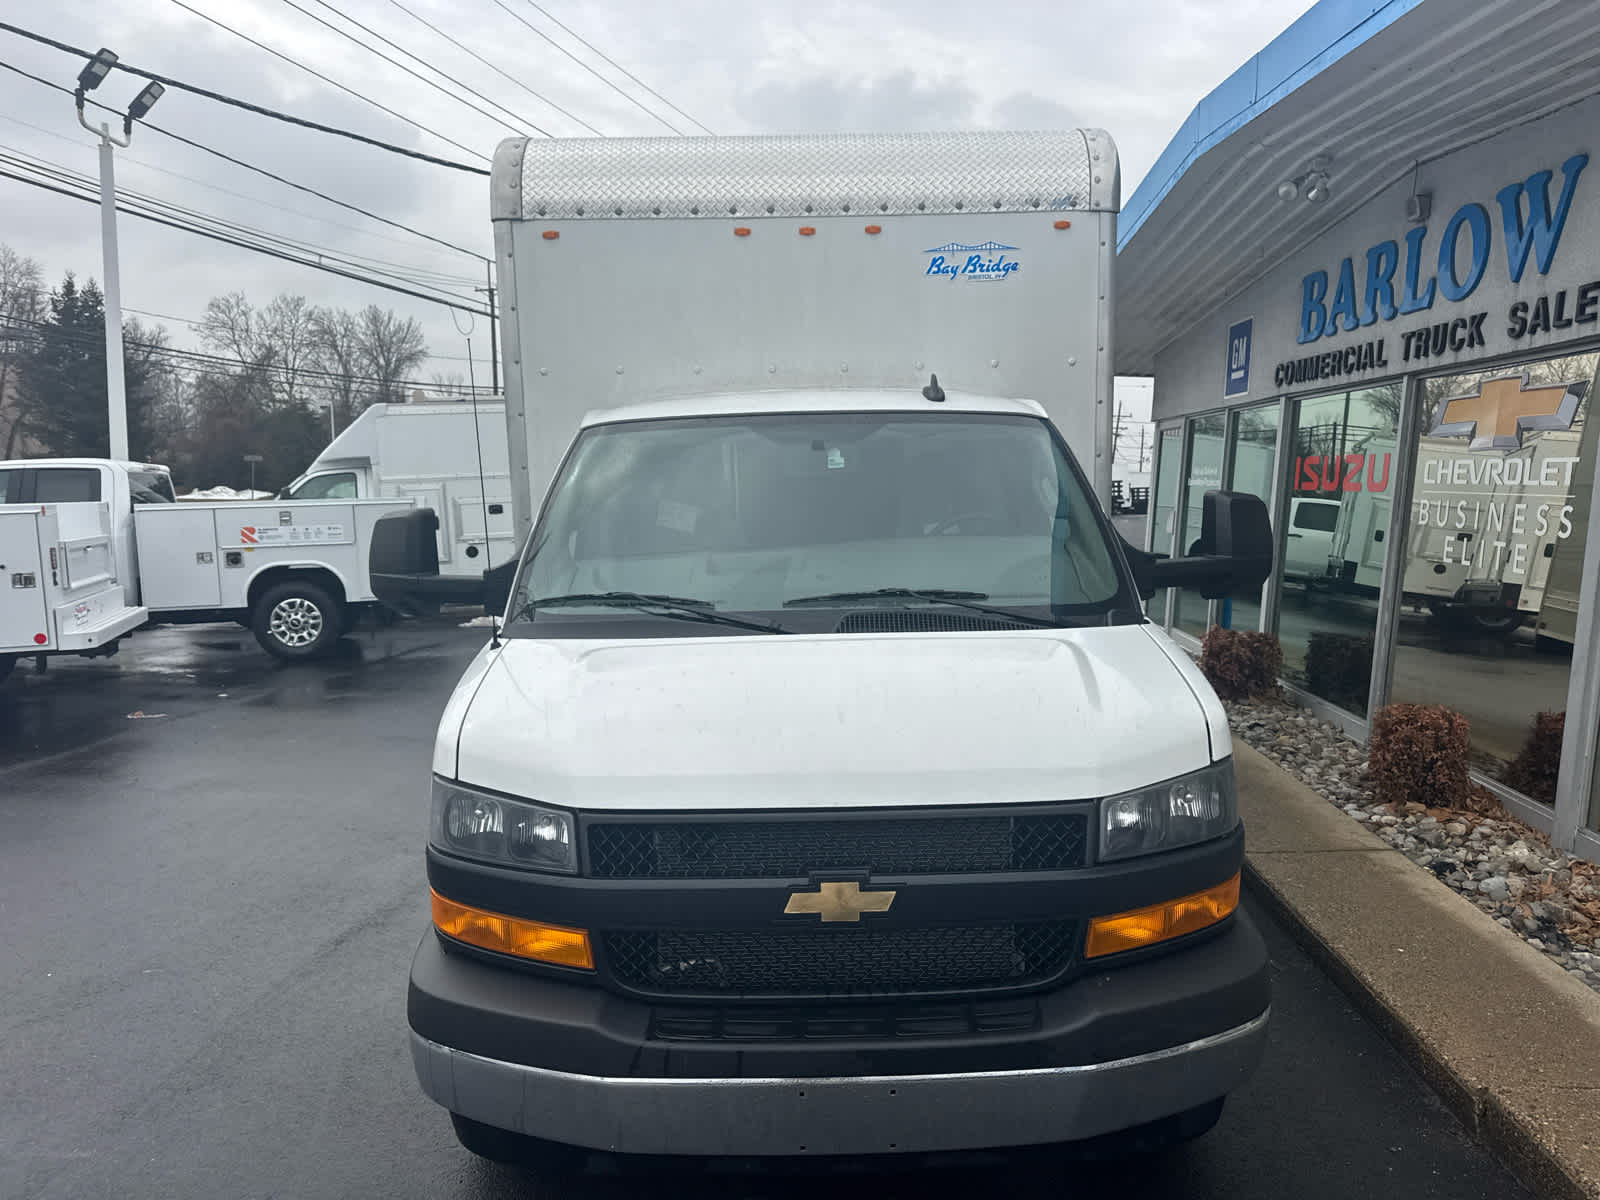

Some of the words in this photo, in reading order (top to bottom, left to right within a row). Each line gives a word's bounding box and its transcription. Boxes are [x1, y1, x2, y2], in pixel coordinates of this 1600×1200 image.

[926, 255, 960, 280] Bay
[961, 254, 1019, 278] Bridge
[1296, 153, 1589, 344] BARLOW
[1231, 336, 1247, 369] GM
[1274, 339, 1388, 388] COMMERCIAL
[1401, 312, 1488, 362] TRUCK
[1293, 453, 1391, 493] ISUZU
[1423, 457, 1580, 487] CHEVROLET
[1418, 499, 1574, 539] BUSINESS
[1443, 536, 1528, 574] ELITE
